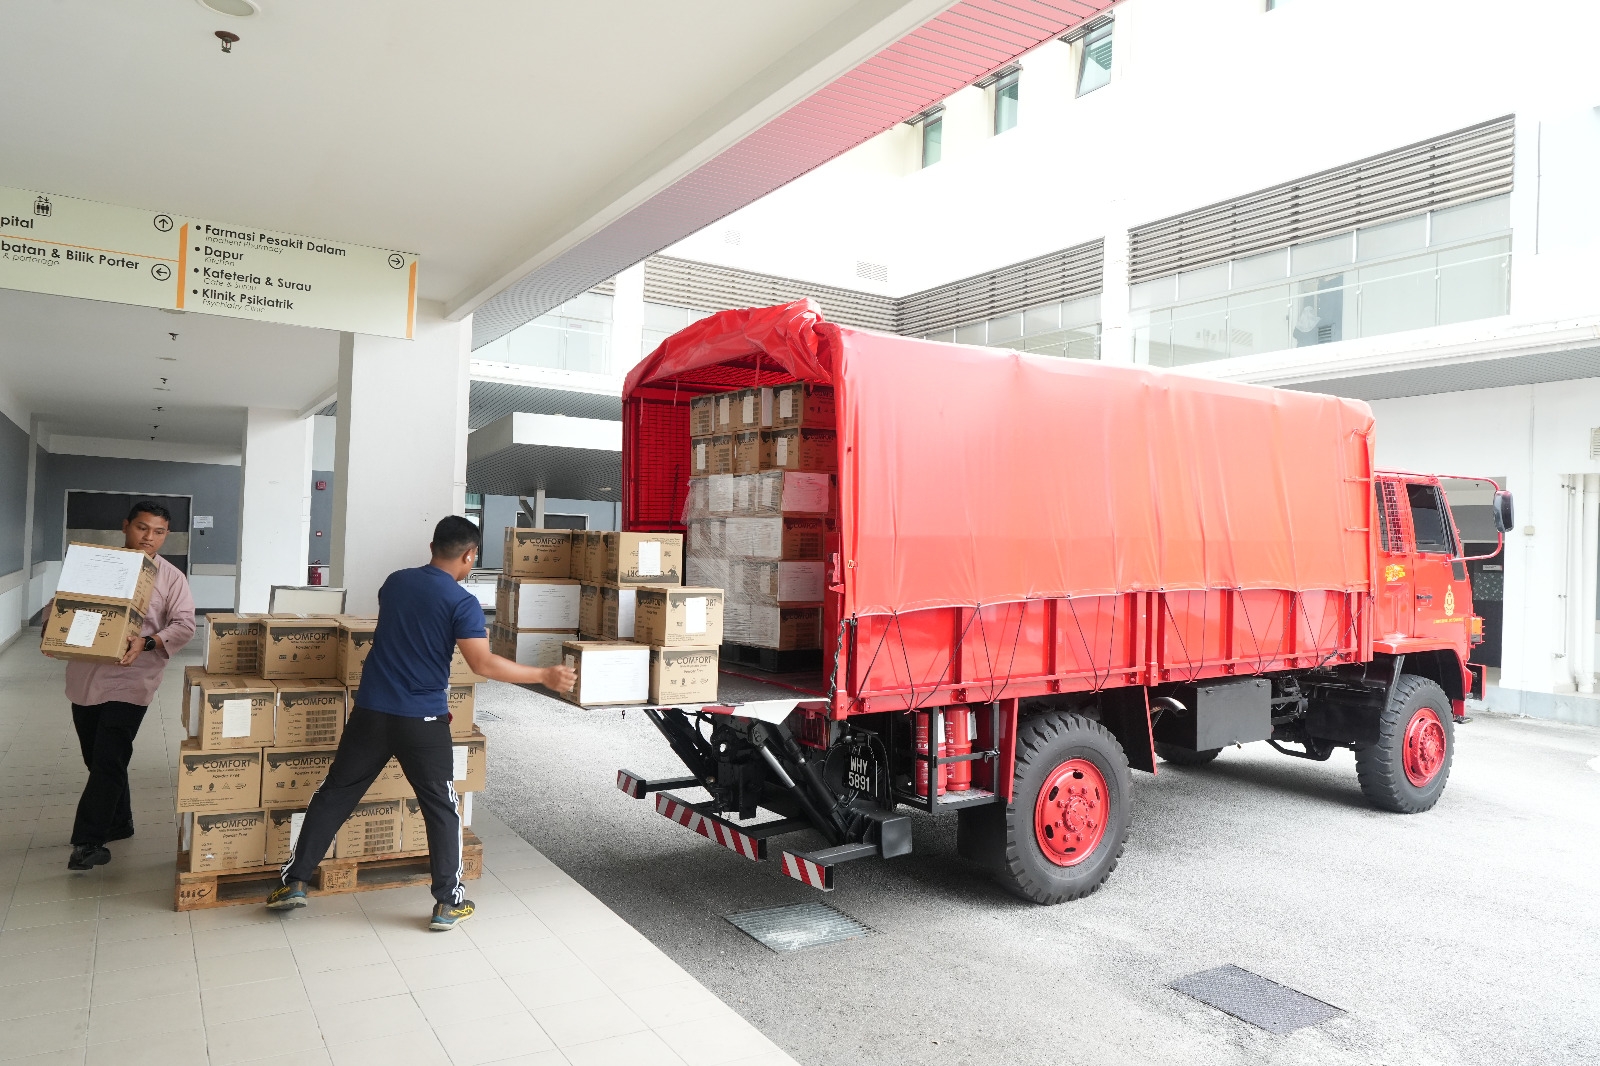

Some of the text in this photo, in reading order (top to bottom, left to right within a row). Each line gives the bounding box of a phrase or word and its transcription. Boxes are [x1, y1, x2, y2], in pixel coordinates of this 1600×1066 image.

[205, 224, 347, 257] Farmasi Pesakit Dalam
[1, 240, 140, 270] batan & Bilik Porter
[204, 245, 244, 260] Dapur
[203, 266, 312, 292] Kafeteria & Surau
[202, 288, 294, 310] Klinik Psikiatrik
[529, 537, 565, 545] COMFORT
[287, 632, 330, 641] COMFORT
[676, 656, 712, 665] COMFORT
[296, 697, 337, 706] COMFORT
[202, 759, 252, 769] COMFORT
[285, 756, 331, 767] COMFORT
[850, 755, 868, 775] WHY
[848, 771, 870, 792] 5891
[355, 805, 394, 818] COMFORT
[214, 818, 258, 829] COMFORT
